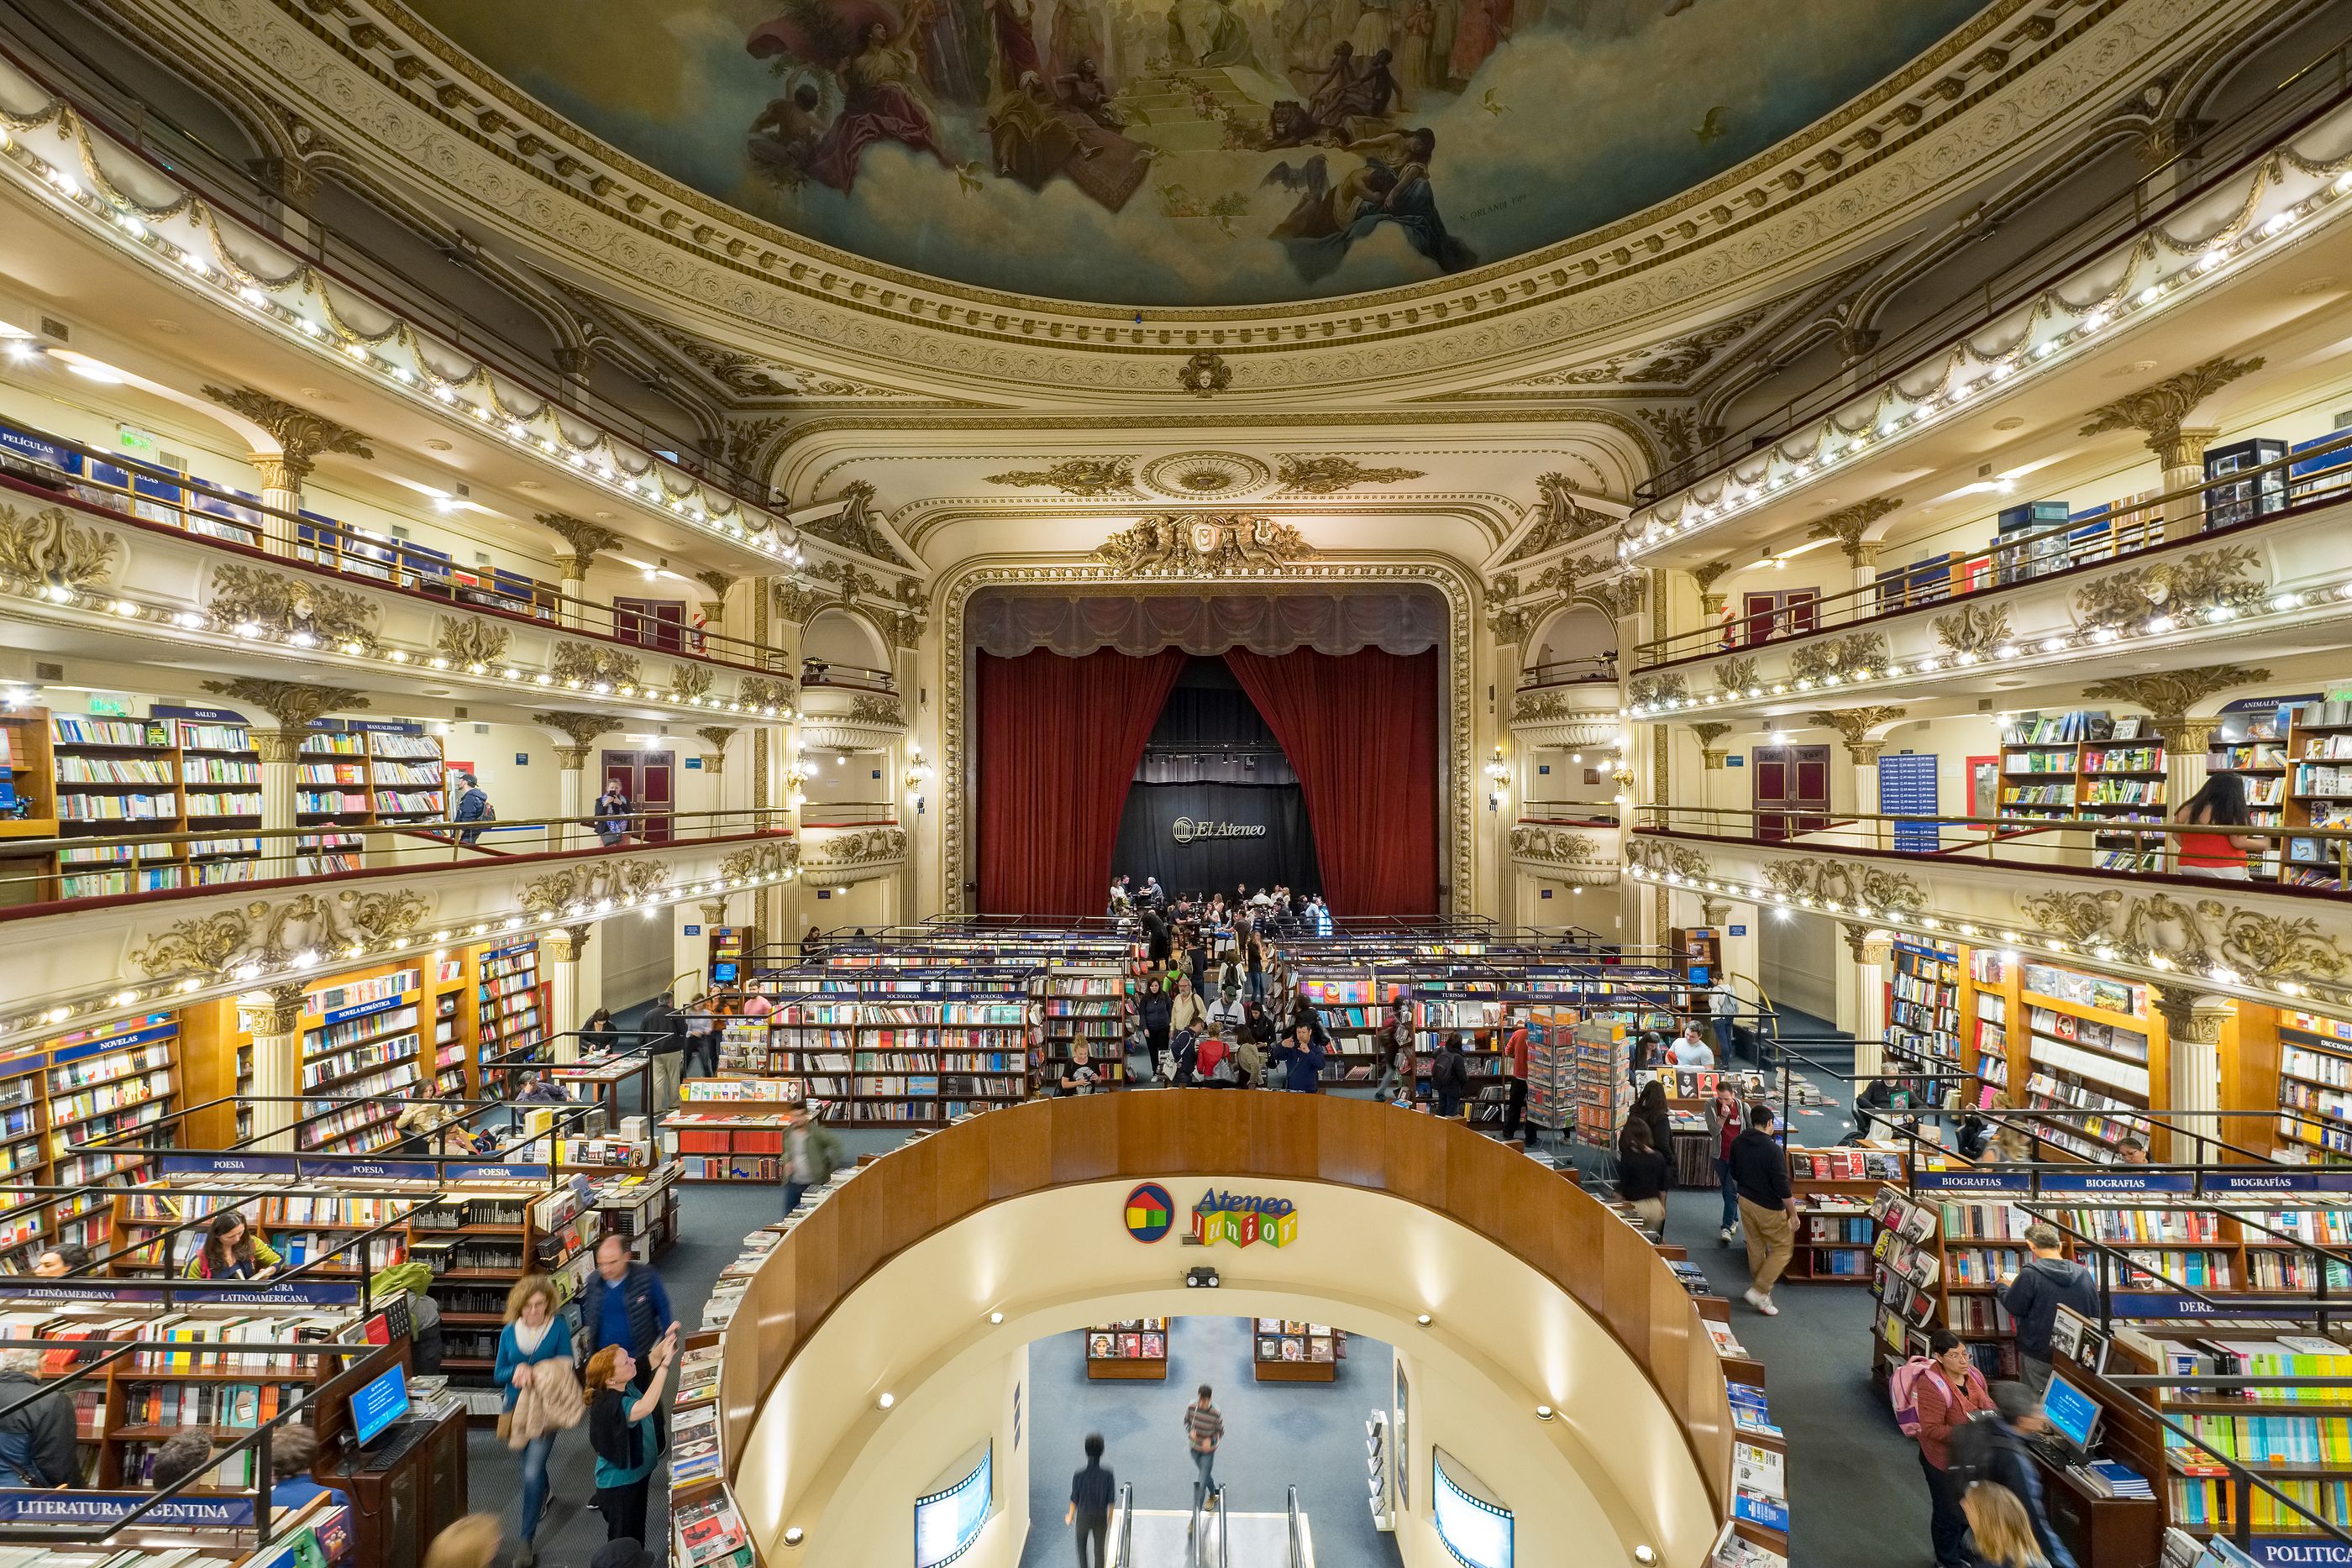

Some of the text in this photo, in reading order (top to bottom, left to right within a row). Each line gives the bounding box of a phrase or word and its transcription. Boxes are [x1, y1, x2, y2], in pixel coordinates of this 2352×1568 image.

[1470, 201, 1507, 219] ORLANDI
[3, 432, 55, 454] PELÍCULAS
[2242, 699, 2280, 709] ANIMALES
[195, 710, 217, 719] SALUD
[366, 723, 404, 732] MANUALIDADES
[1194, 821, 1266, 836] El Ateneo
[338, 999, 391, 1018] NOVELA ROMÁNTICA
[99, 1035, 139, 1050] NOVELAS
[213, 1161, 244, 1169] POESIA
[353, 1166, 385, 1174] POESIA
[478, 1167, 511, 1176] POESIA
[1942, 1177, 2002, 1187] BIOGRAFIAS
[2086, 1179, 2145, 1188] BIOGRAFIAS
[2230, 1176, 2292, 1187] BIOGRAFÍAS
[1195, 1188, 1294, 1214] Ateneo
[1194, 1214, 1295, 1241] Junior
[28, 1288, 116, 1300] LATINOAMERICANA
[220, 1293, 309, 1303] LATINOAMERICANA
[17, 1501, 123, 1516] LITERATURA
[129, 1503, 228, 1518] AGENTINA
